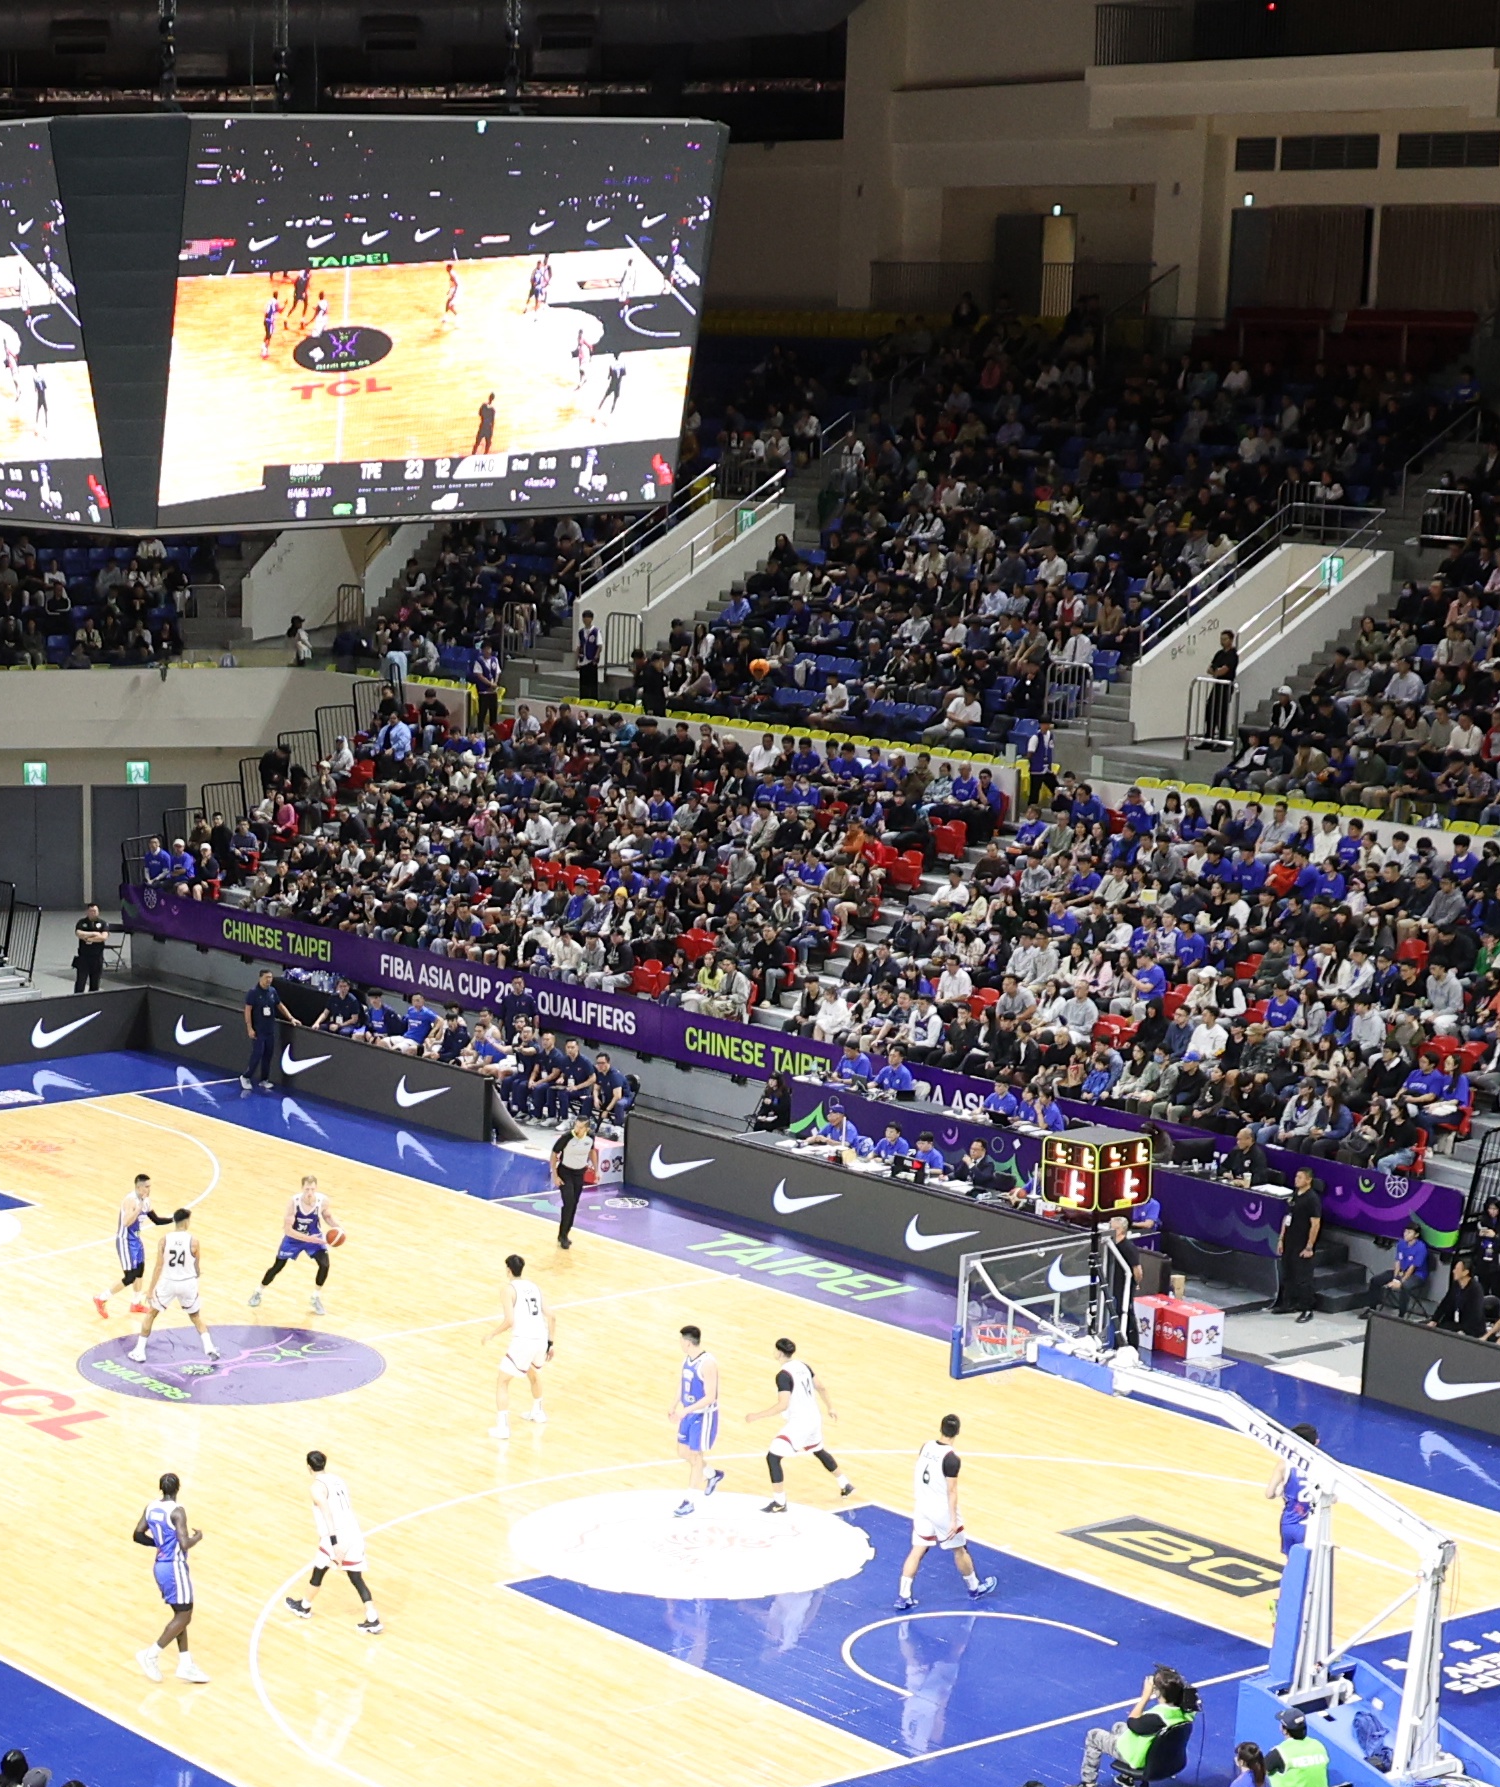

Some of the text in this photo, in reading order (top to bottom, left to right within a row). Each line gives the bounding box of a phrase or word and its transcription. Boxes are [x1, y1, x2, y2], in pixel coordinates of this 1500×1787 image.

[309, 253, 391, 268] TAIPEI
[291, 377, 393, 400] TCL
[361, 461, 382, 480] TPE
[405, 460, 424, 480] 23
[435, 458, 450, 478] 12
[222, 917, 332, 963] CHINESE TAIPEI
[380, 954, 413, 984] FIBA
[417, 961, 453, 993] ASIA
[457, 971, 490, 1003] CUP
[537, 991, 637, 1037] QUALIFIERS
[684, 1026, 765, 1070] CHINESE
[168, 1249, 186, 1268] 24
[687, 1231, 918, 1301] TAIPEI
[524, 1297, 540, 1317] 13
[91, 1359, 192, 1400] QUALIFIERS
[1249, 1421, 1311, 1472] GARED
[921, 1465, 931, 1485] 6
